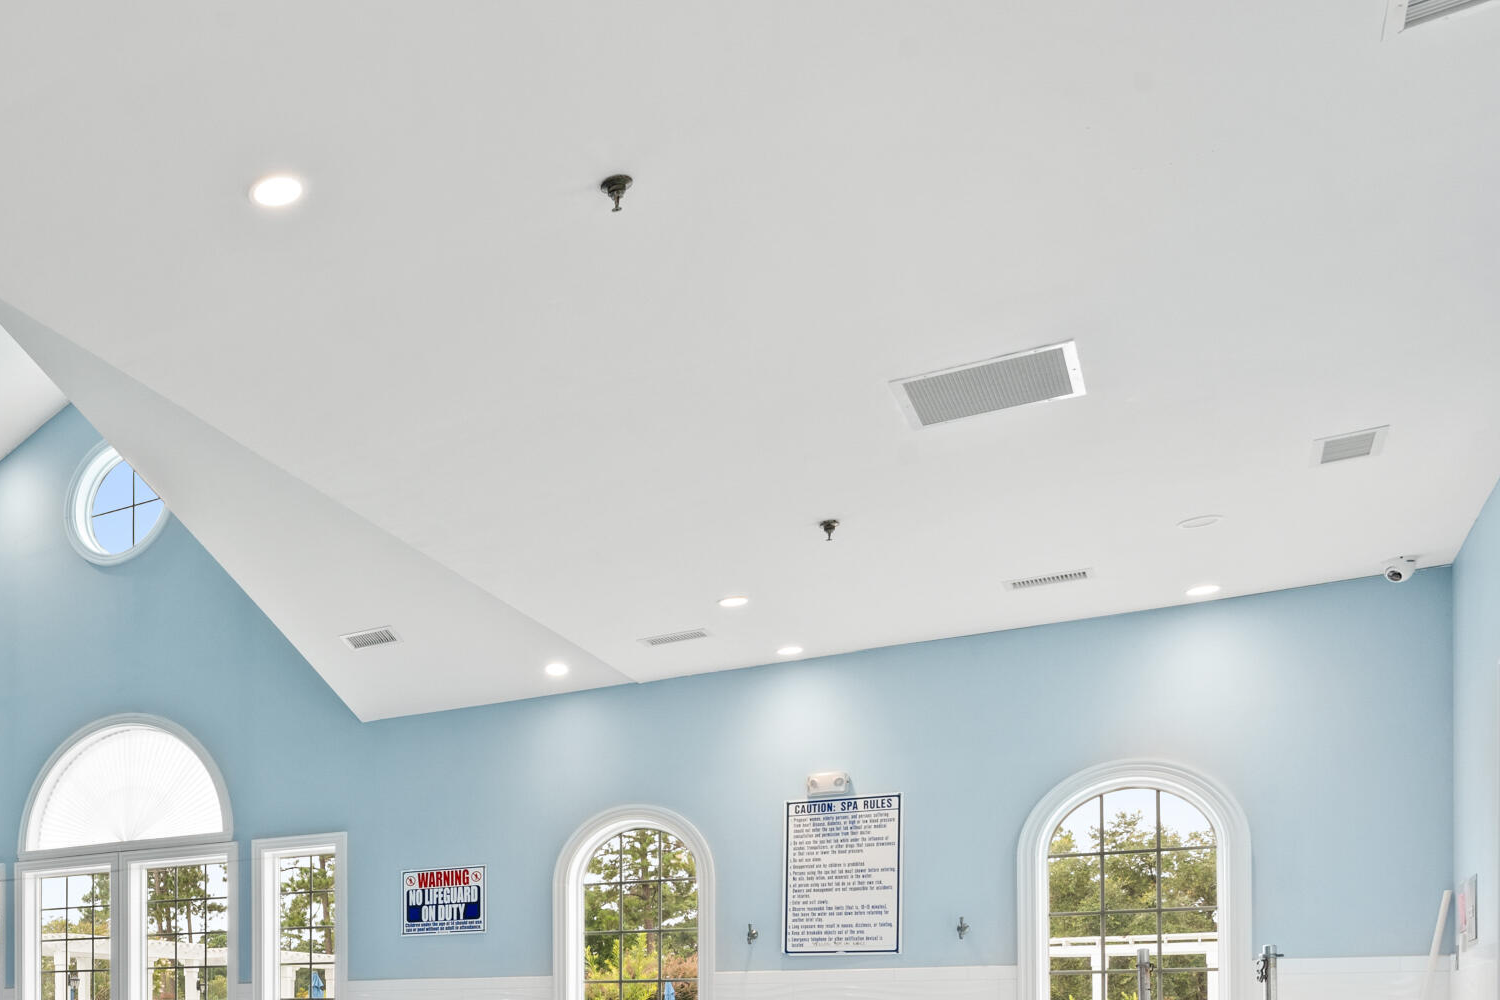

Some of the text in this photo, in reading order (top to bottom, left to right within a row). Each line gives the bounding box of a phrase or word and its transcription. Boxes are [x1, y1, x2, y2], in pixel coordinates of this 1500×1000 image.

[795, 798, 892, 814] CAUTION: SPA RULES
[418, 870, 470, 888] WARNING
[408, 886, 478, 906] NO LIFEGUARD
[422, 904, 466, 922] ON DUTY
